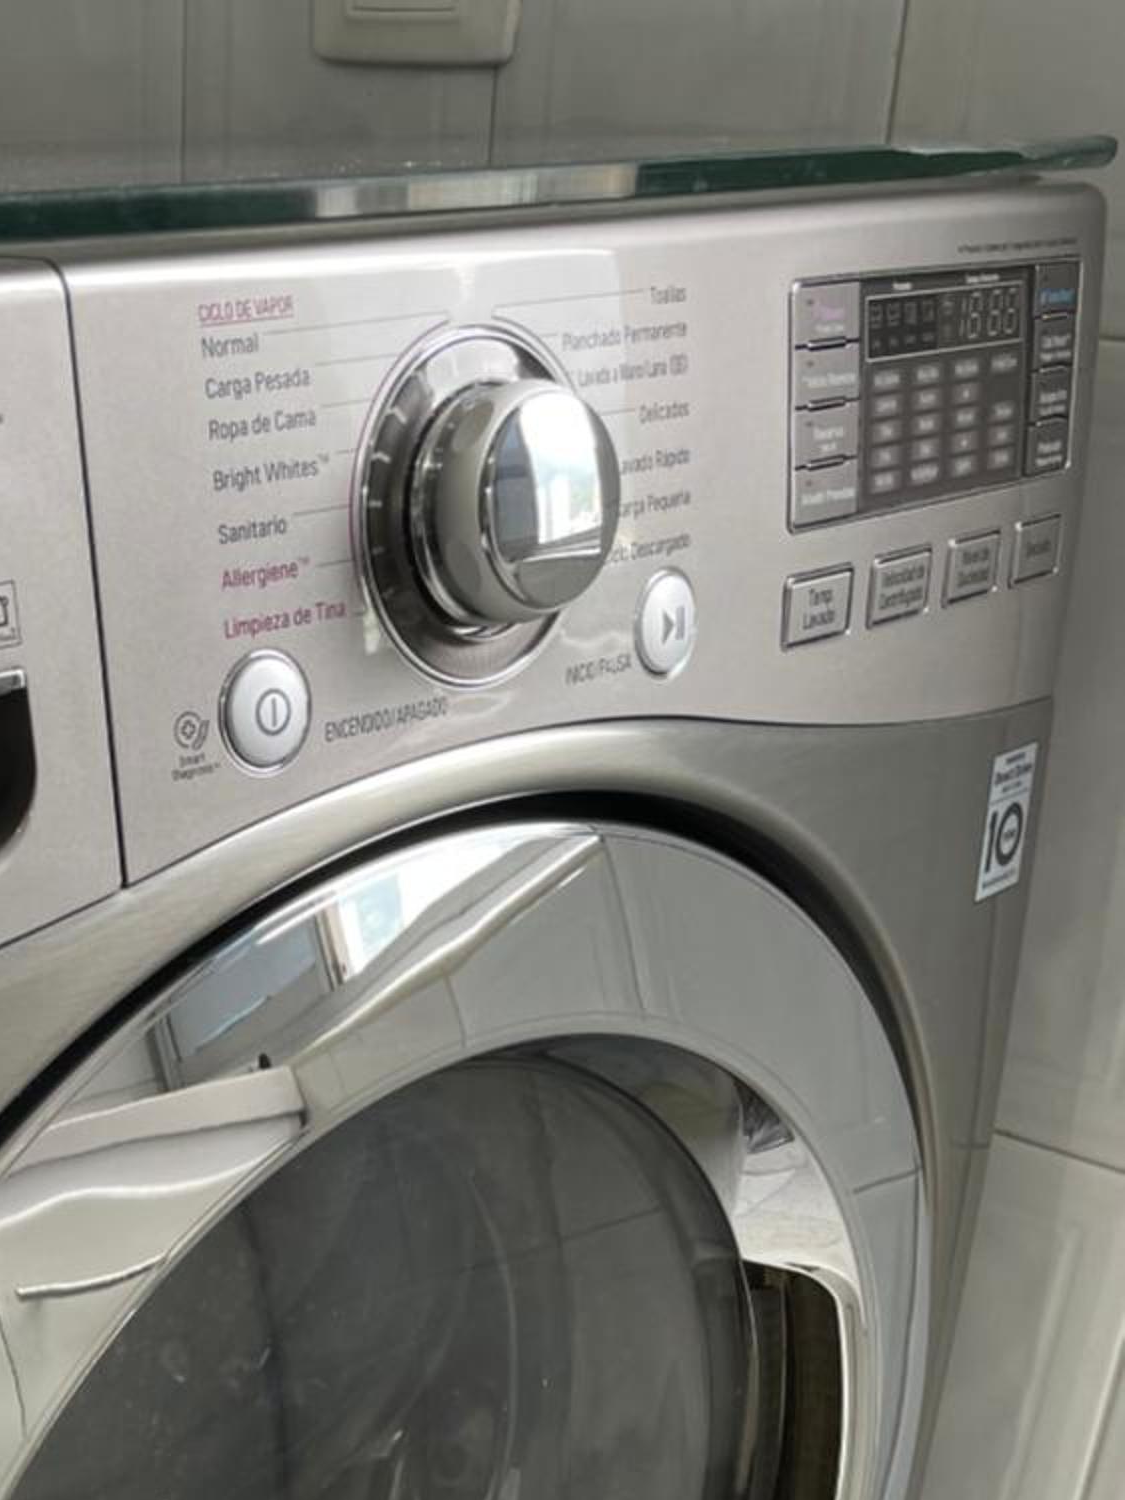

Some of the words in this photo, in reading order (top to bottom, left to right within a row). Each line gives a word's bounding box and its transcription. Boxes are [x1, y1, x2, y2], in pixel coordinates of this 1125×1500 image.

[202, 333, 259, 358] Normal
[205, 376, 251, 400] Carga
[255, 368, 310, 392] Pesada
[208, 418, 249, 443] Ropa
[251, 414, 272, 434] de
[274, 409, 317, 430] Cama
[213, 462, 262, 491] Bright
[218, 516, 288, 545] Sanitario
[225, 610, 291, 640] Limpieza
[293, 606, 313, 627] de
[315, 600, 347, 622] Tina
